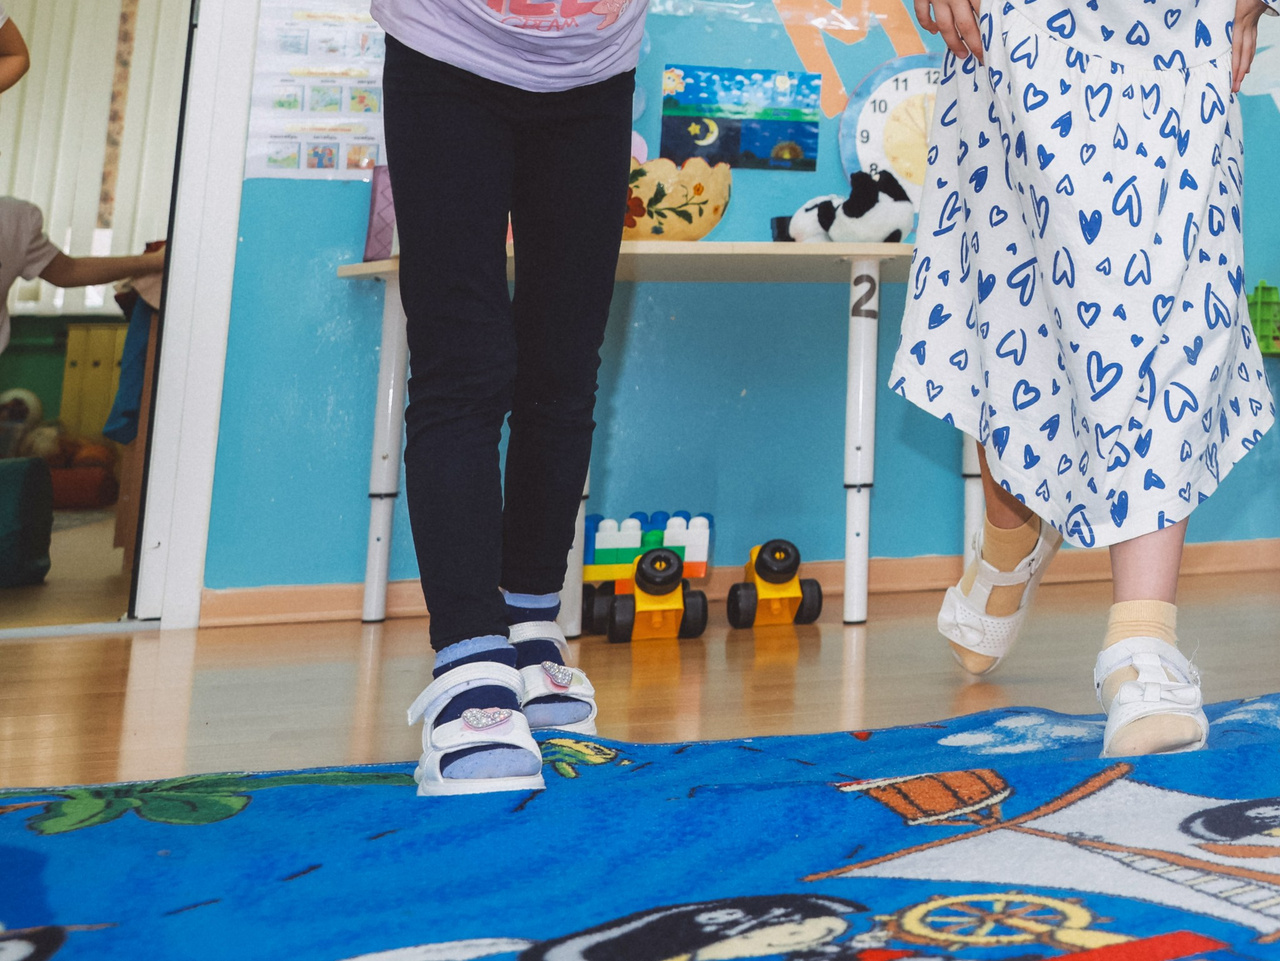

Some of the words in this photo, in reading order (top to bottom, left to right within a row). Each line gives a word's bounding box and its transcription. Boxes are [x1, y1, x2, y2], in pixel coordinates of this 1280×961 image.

[893, 77, 909, 92] 11
[924, 70, 940, 85] 12
[871, 99, 888, 114] 10
[860, 129, 870, 144] 9
[851, 274, 879, 320] 2
